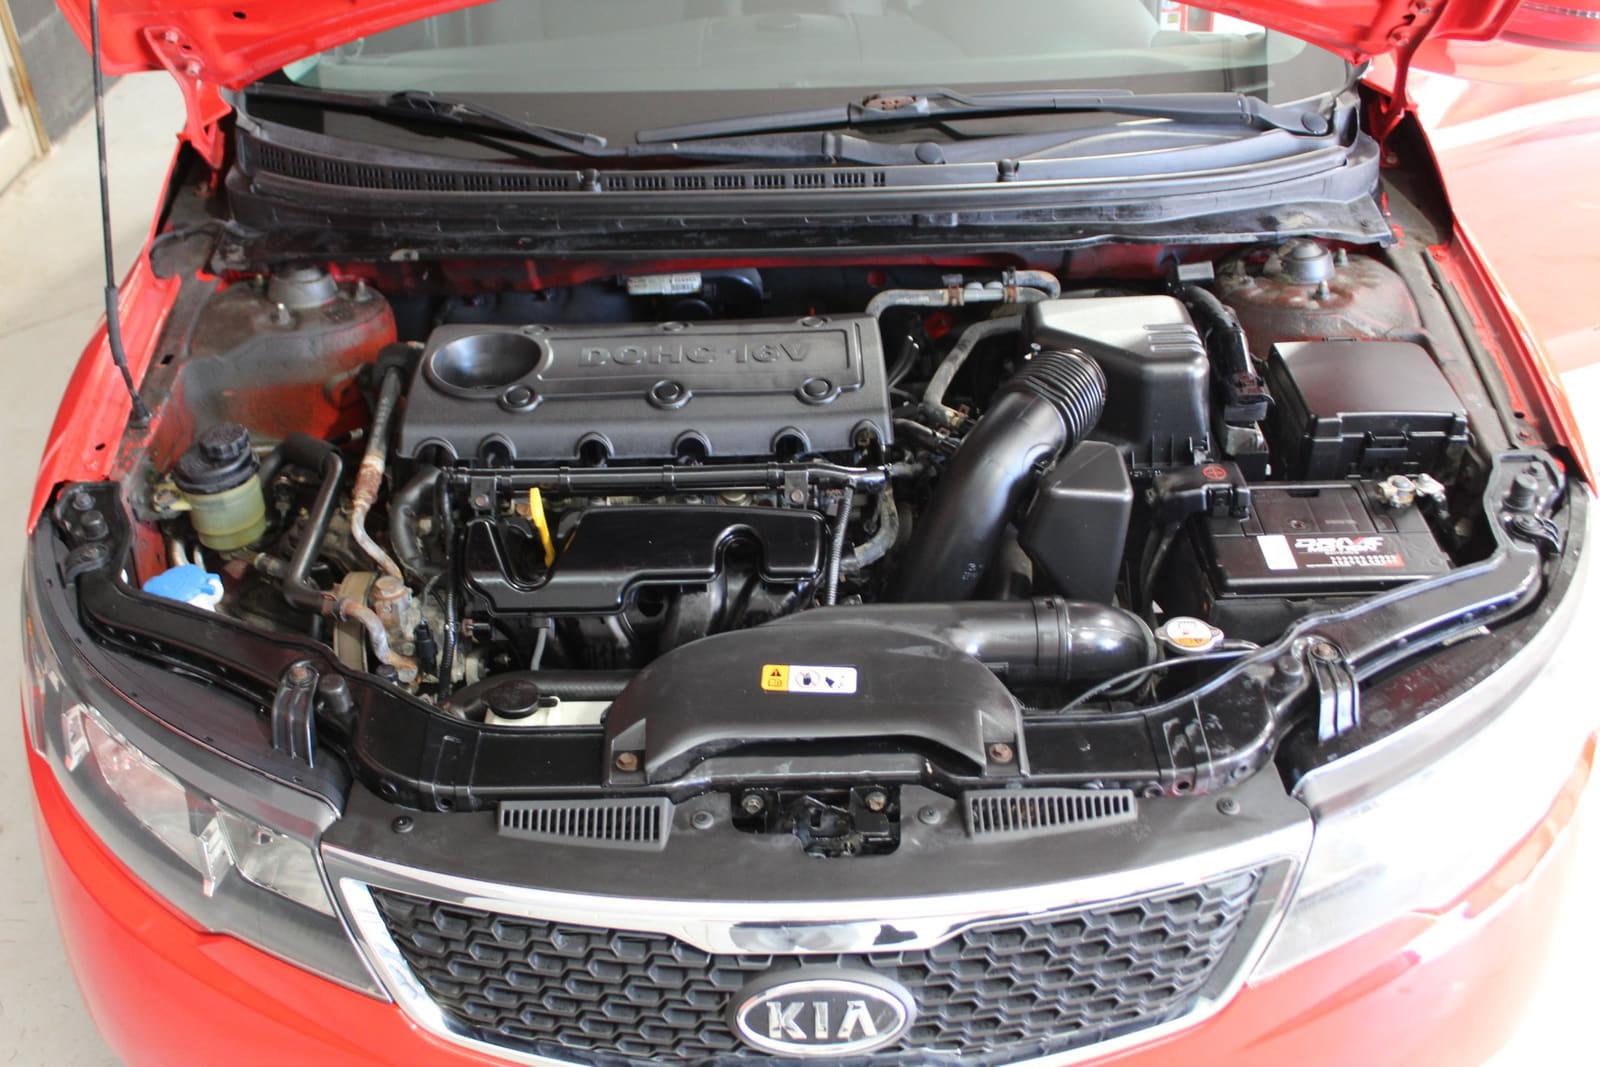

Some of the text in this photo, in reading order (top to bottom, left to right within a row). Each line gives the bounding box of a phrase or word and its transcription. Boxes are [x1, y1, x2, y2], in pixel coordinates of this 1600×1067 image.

[578, 343, 810, 367] DOHC 16V
[766, 1000, 878, 1040] KIA
